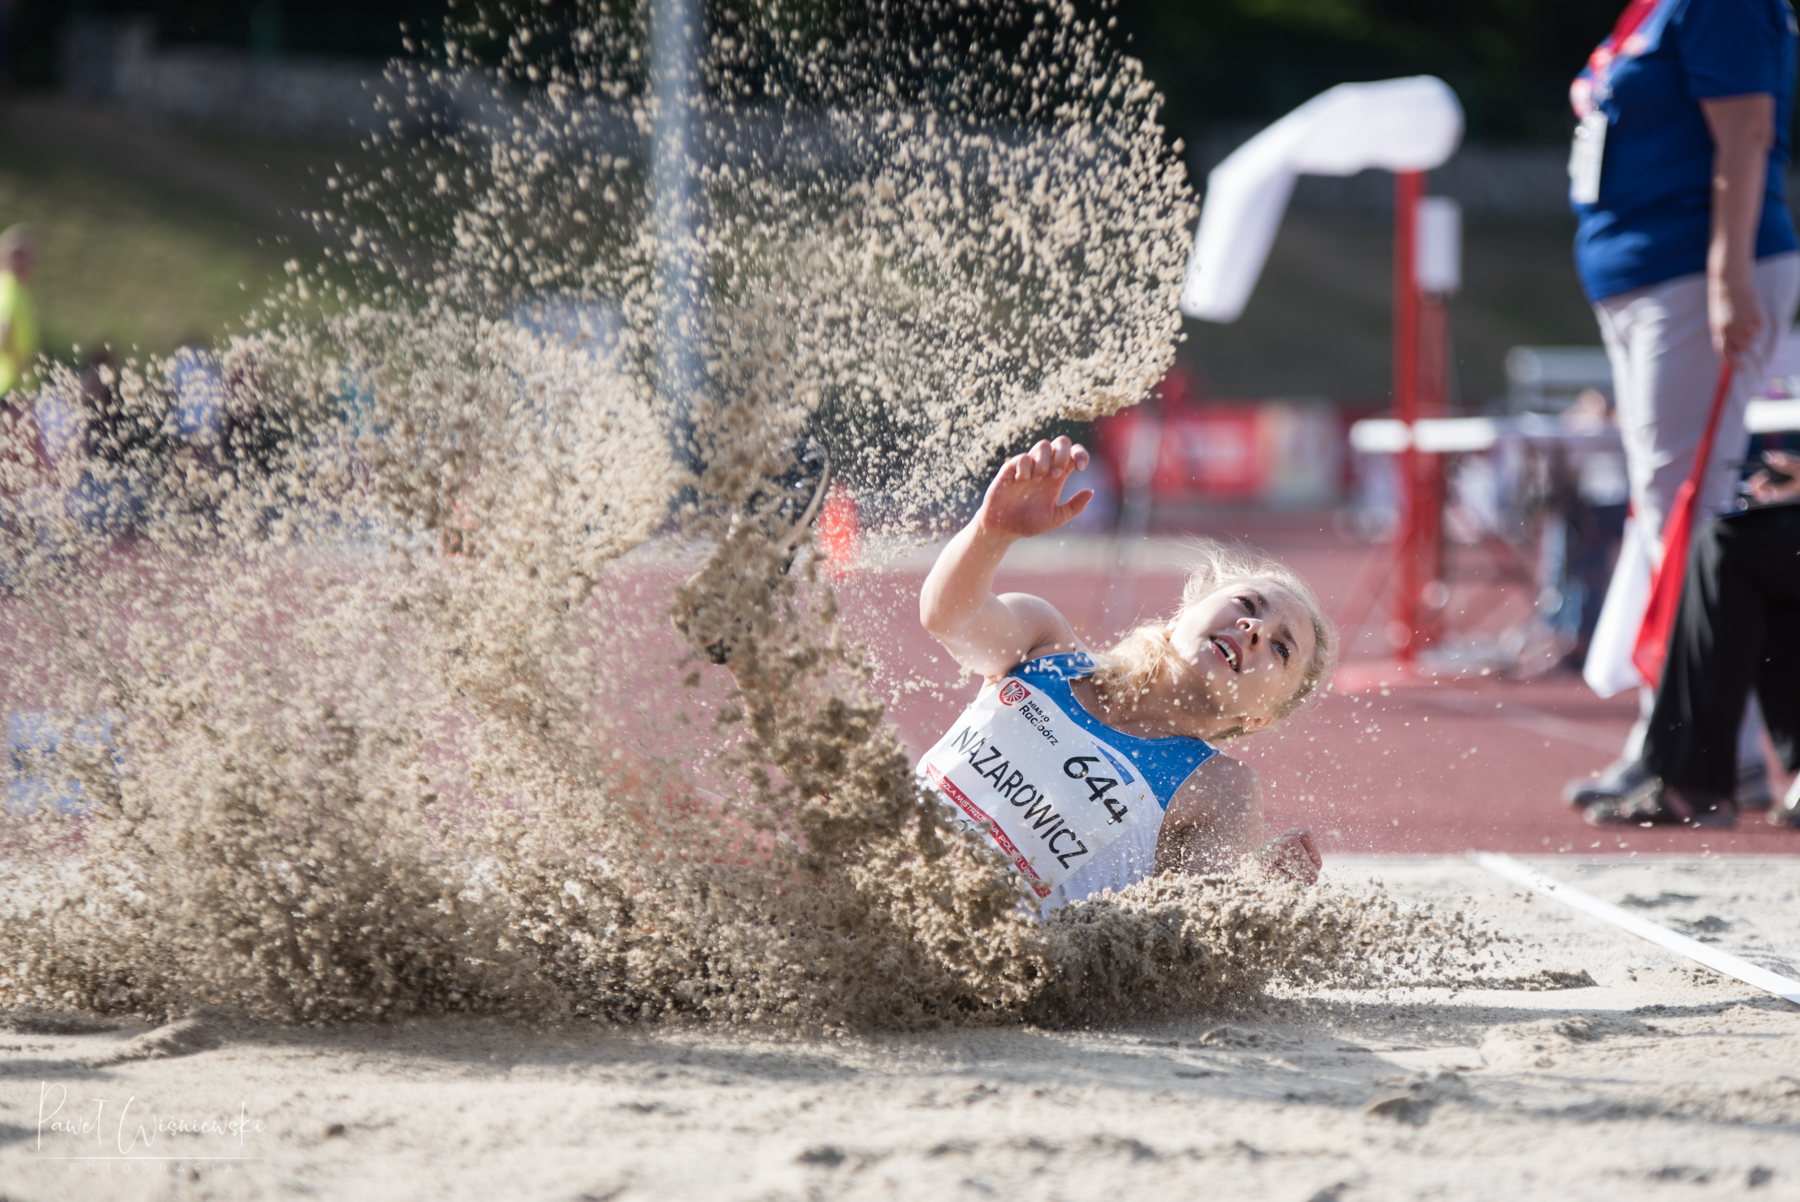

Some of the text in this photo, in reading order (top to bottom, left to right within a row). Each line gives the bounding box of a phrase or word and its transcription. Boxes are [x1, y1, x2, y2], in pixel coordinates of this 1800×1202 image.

[1018, 704, 1059, 746] Racibórz
[950, 725, 1088, 870] NAZAROWICZ
[955, 794, 999, 837] MISTRZOSA
[1063, 756, 1128, 826] 644
